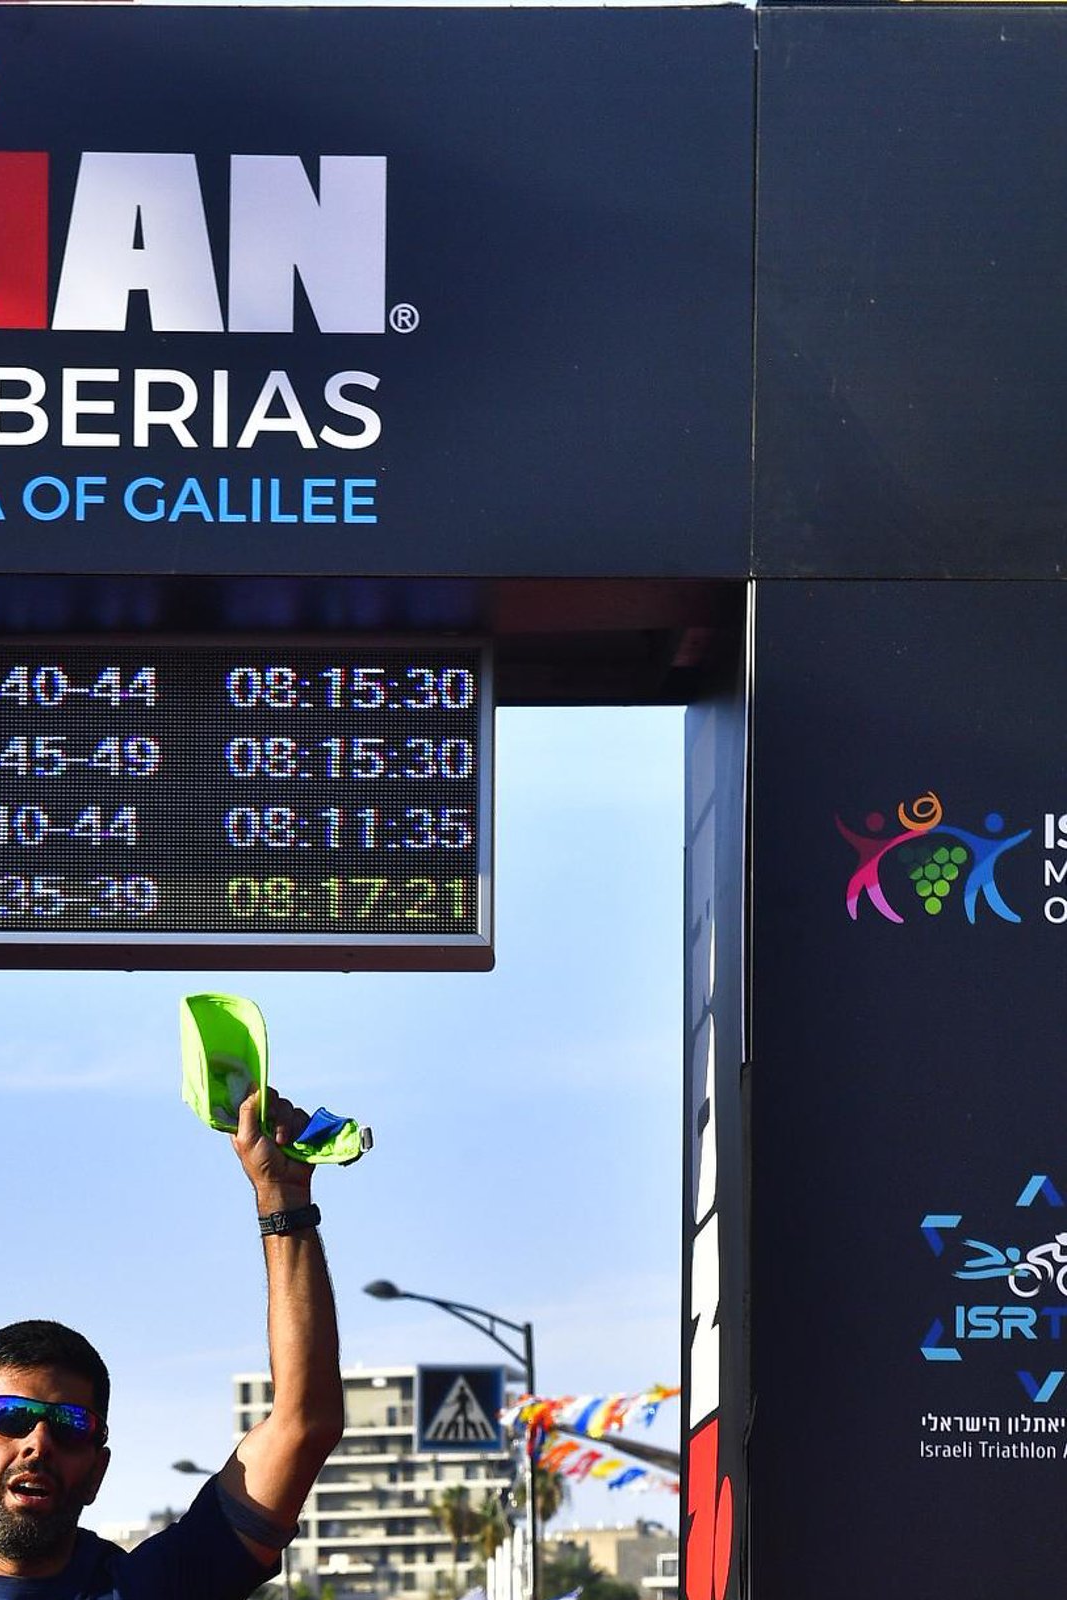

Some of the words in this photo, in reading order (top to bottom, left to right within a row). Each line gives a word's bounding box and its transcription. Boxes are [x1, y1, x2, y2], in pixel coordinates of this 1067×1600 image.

[21, 475, 107, 523] OF
[124, 476, 378, 524] GALILEE
[225, 667, 475, 709] 08:15:30
[225, 737, 475, 778] 08:15:30
[224, 807, 475, 848] 08:11:35
[226, 876, 468, 918] 08:17:21
[921, 1412, 1000, 1432] הישראלי
[920, 1441, 972, 1458] Israeli
[978, 1441, 1056, 1459] Triathlon
